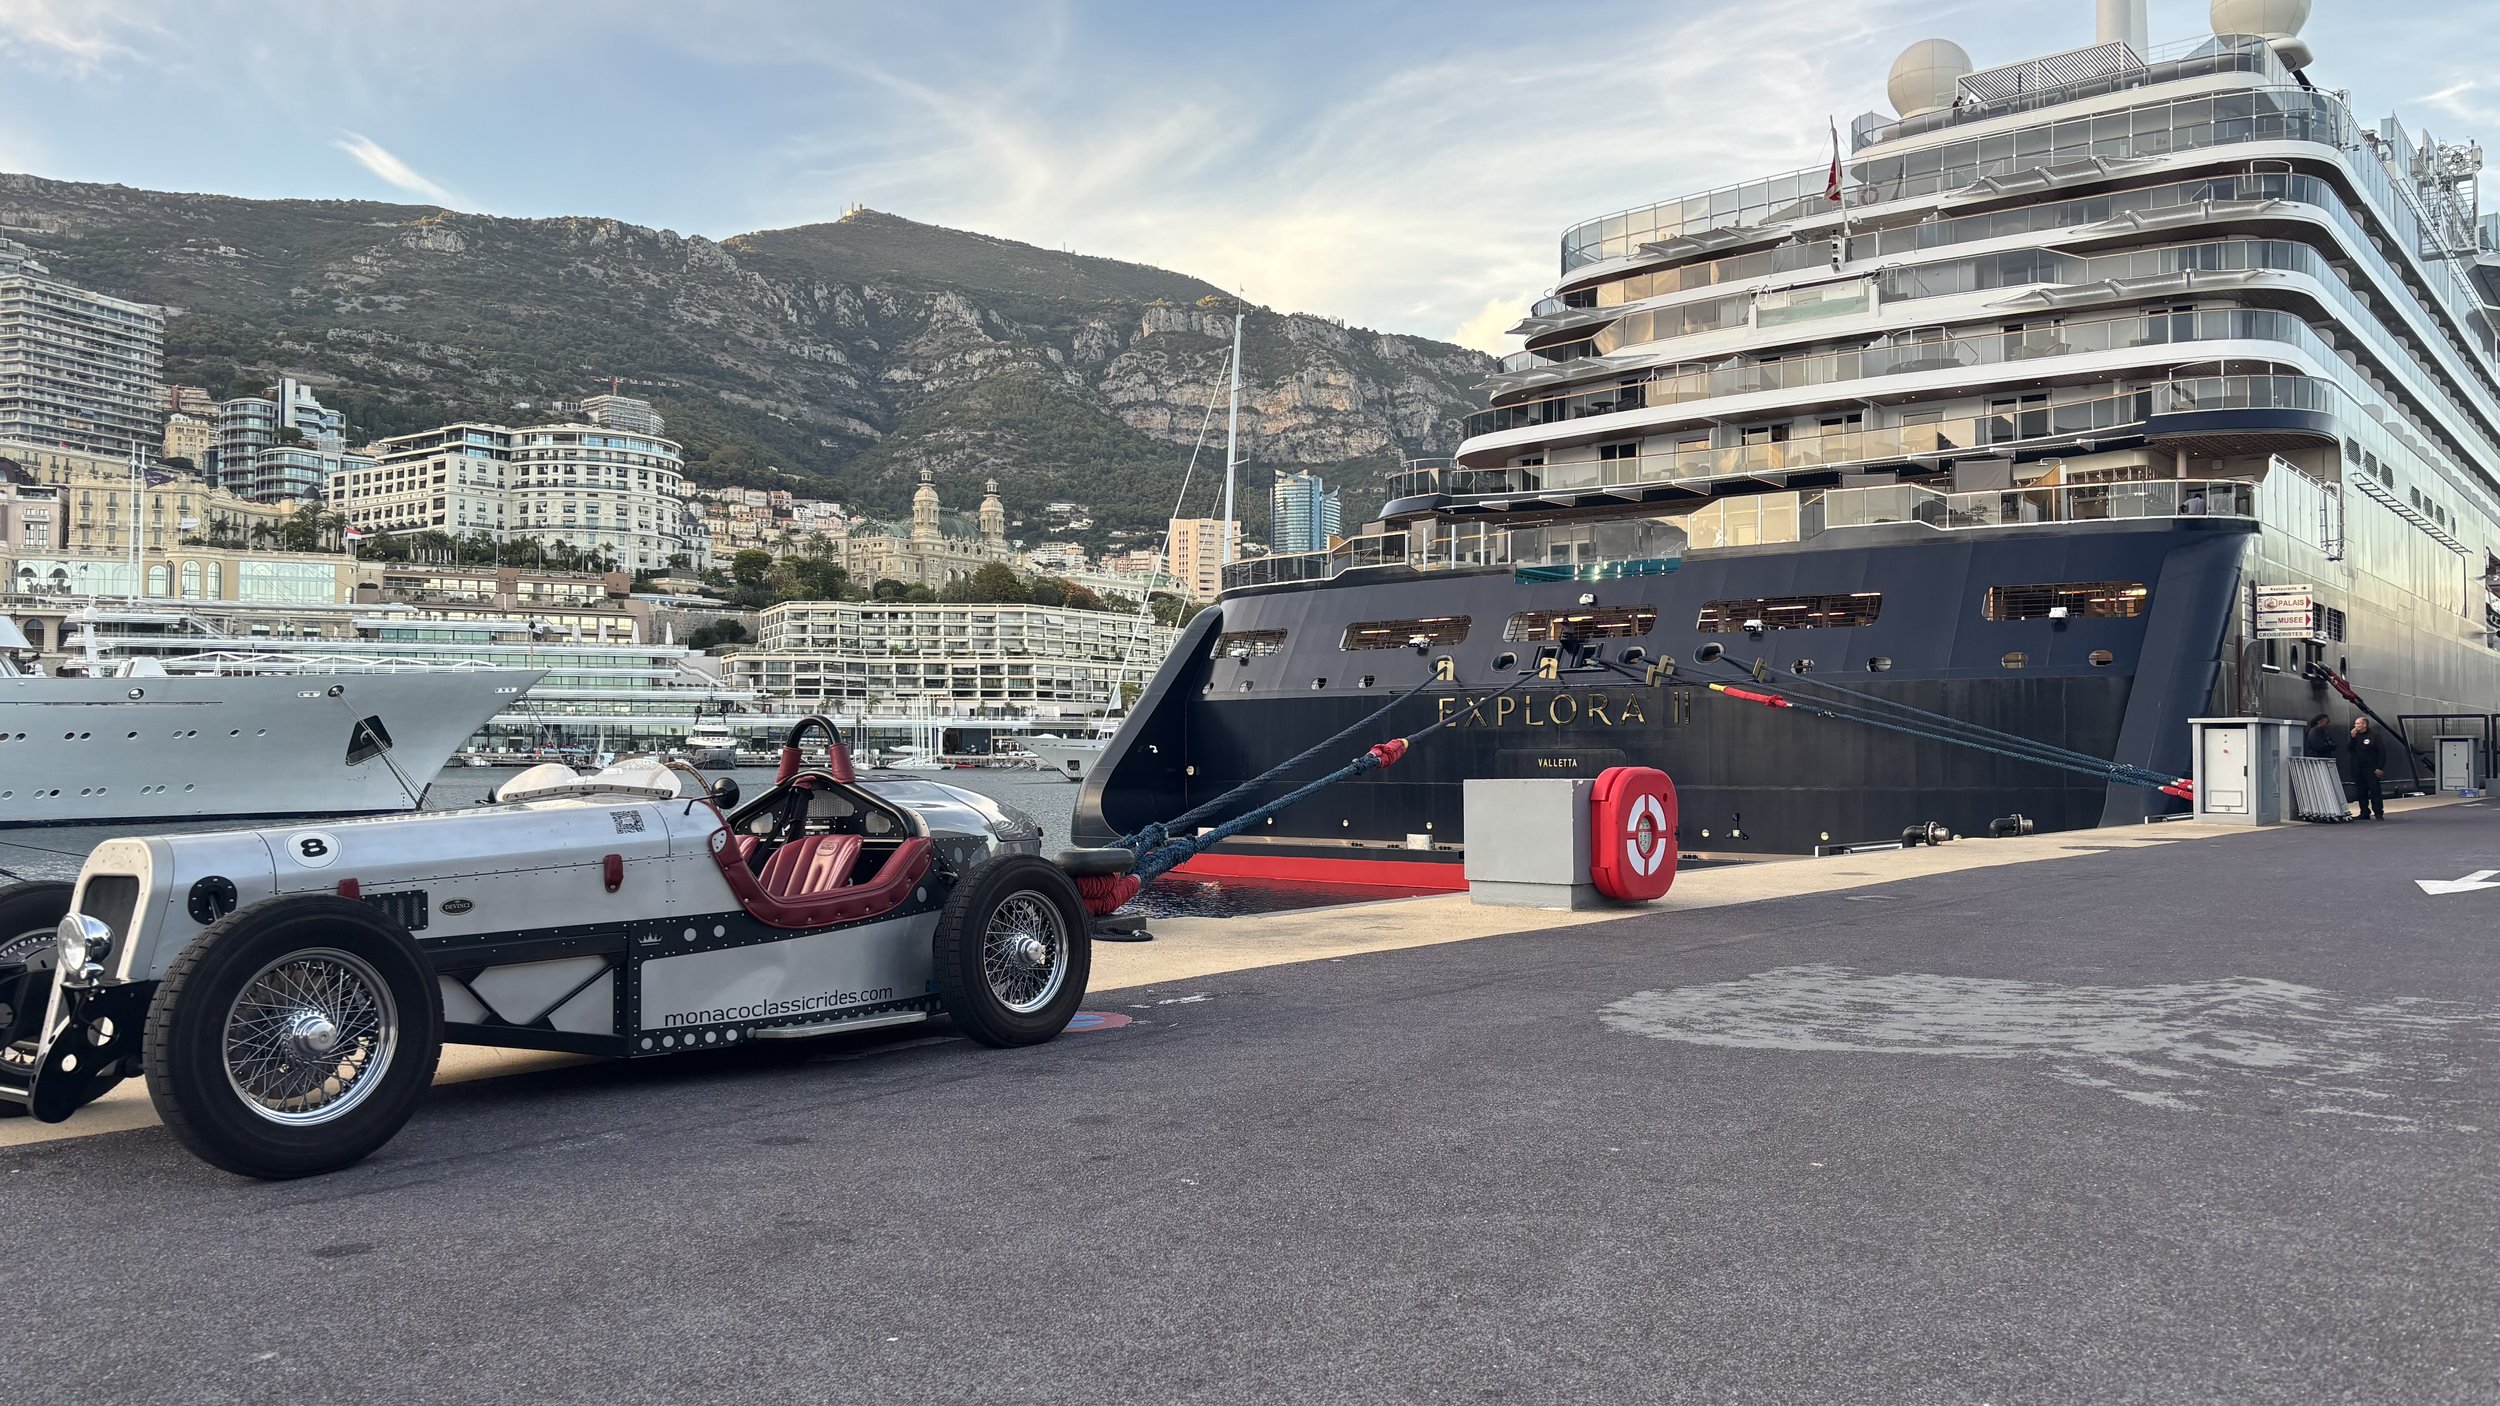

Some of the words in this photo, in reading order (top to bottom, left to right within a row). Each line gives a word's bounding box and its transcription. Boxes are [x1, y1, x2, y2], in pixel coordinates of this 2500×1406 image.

[2278, 599, 2304, 607] PALAIS
[1438, 693, 1646, 727] EXPLORA
[1673, 691, 1690, 725] II
[1538, 758, 1578, 768] VALLETTA
[300, 838, 328, 857] 8
[664, 987, 893, 1027] monacoclassicrides.com
